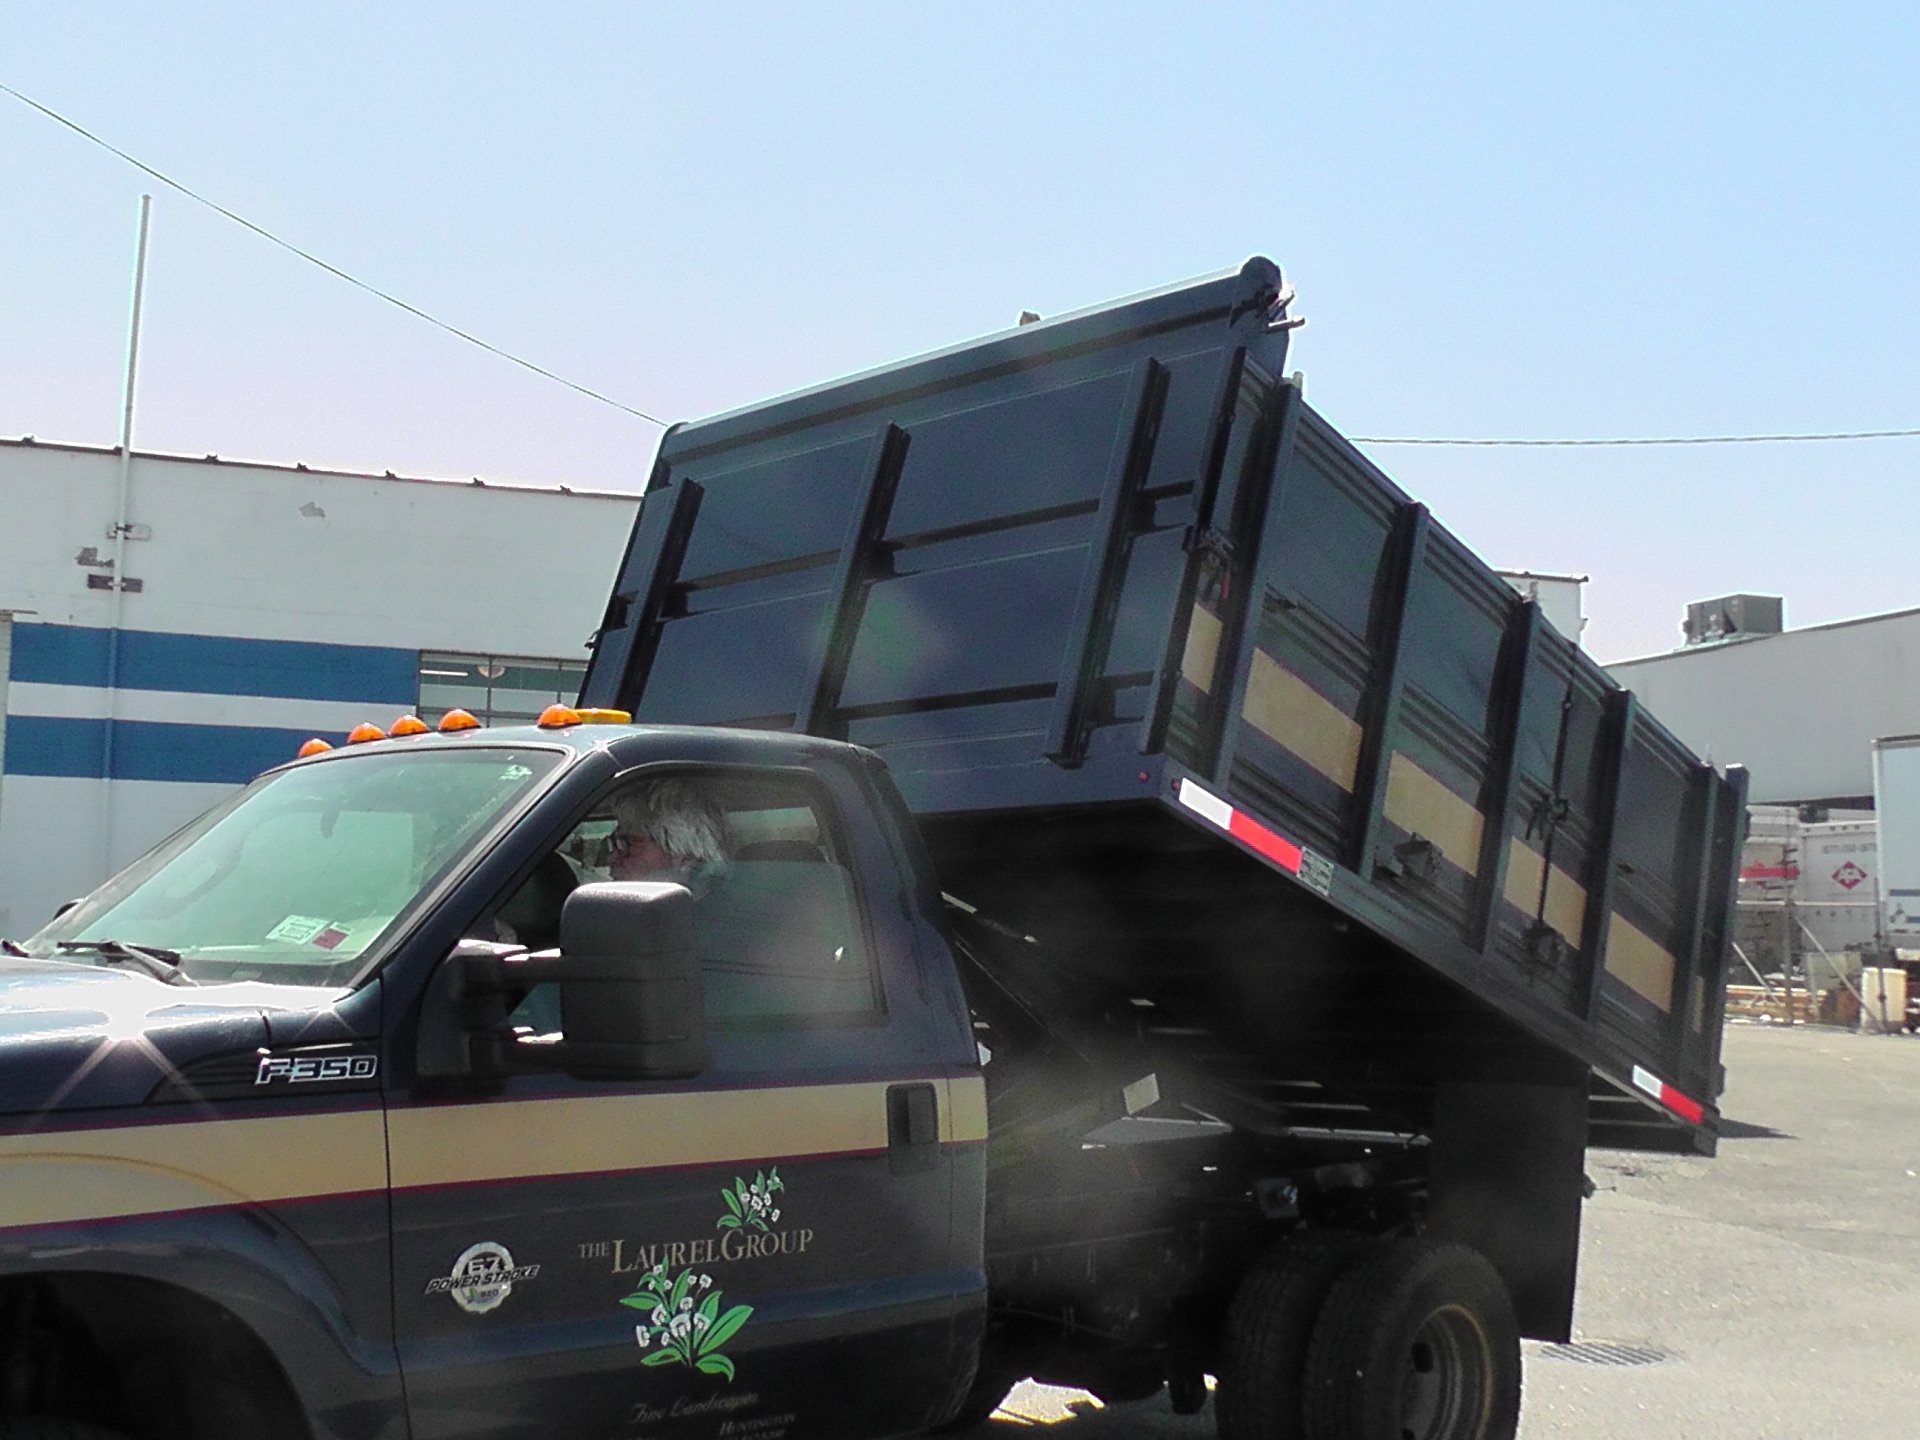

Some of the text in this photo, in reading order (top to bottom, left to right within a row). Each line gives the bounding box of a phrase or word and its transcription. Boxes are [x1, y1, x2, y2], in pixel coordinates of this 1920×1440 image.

[577, 1241, 609, 1259] THE
[427, 1265, 539, 1292] POWER STROKE
